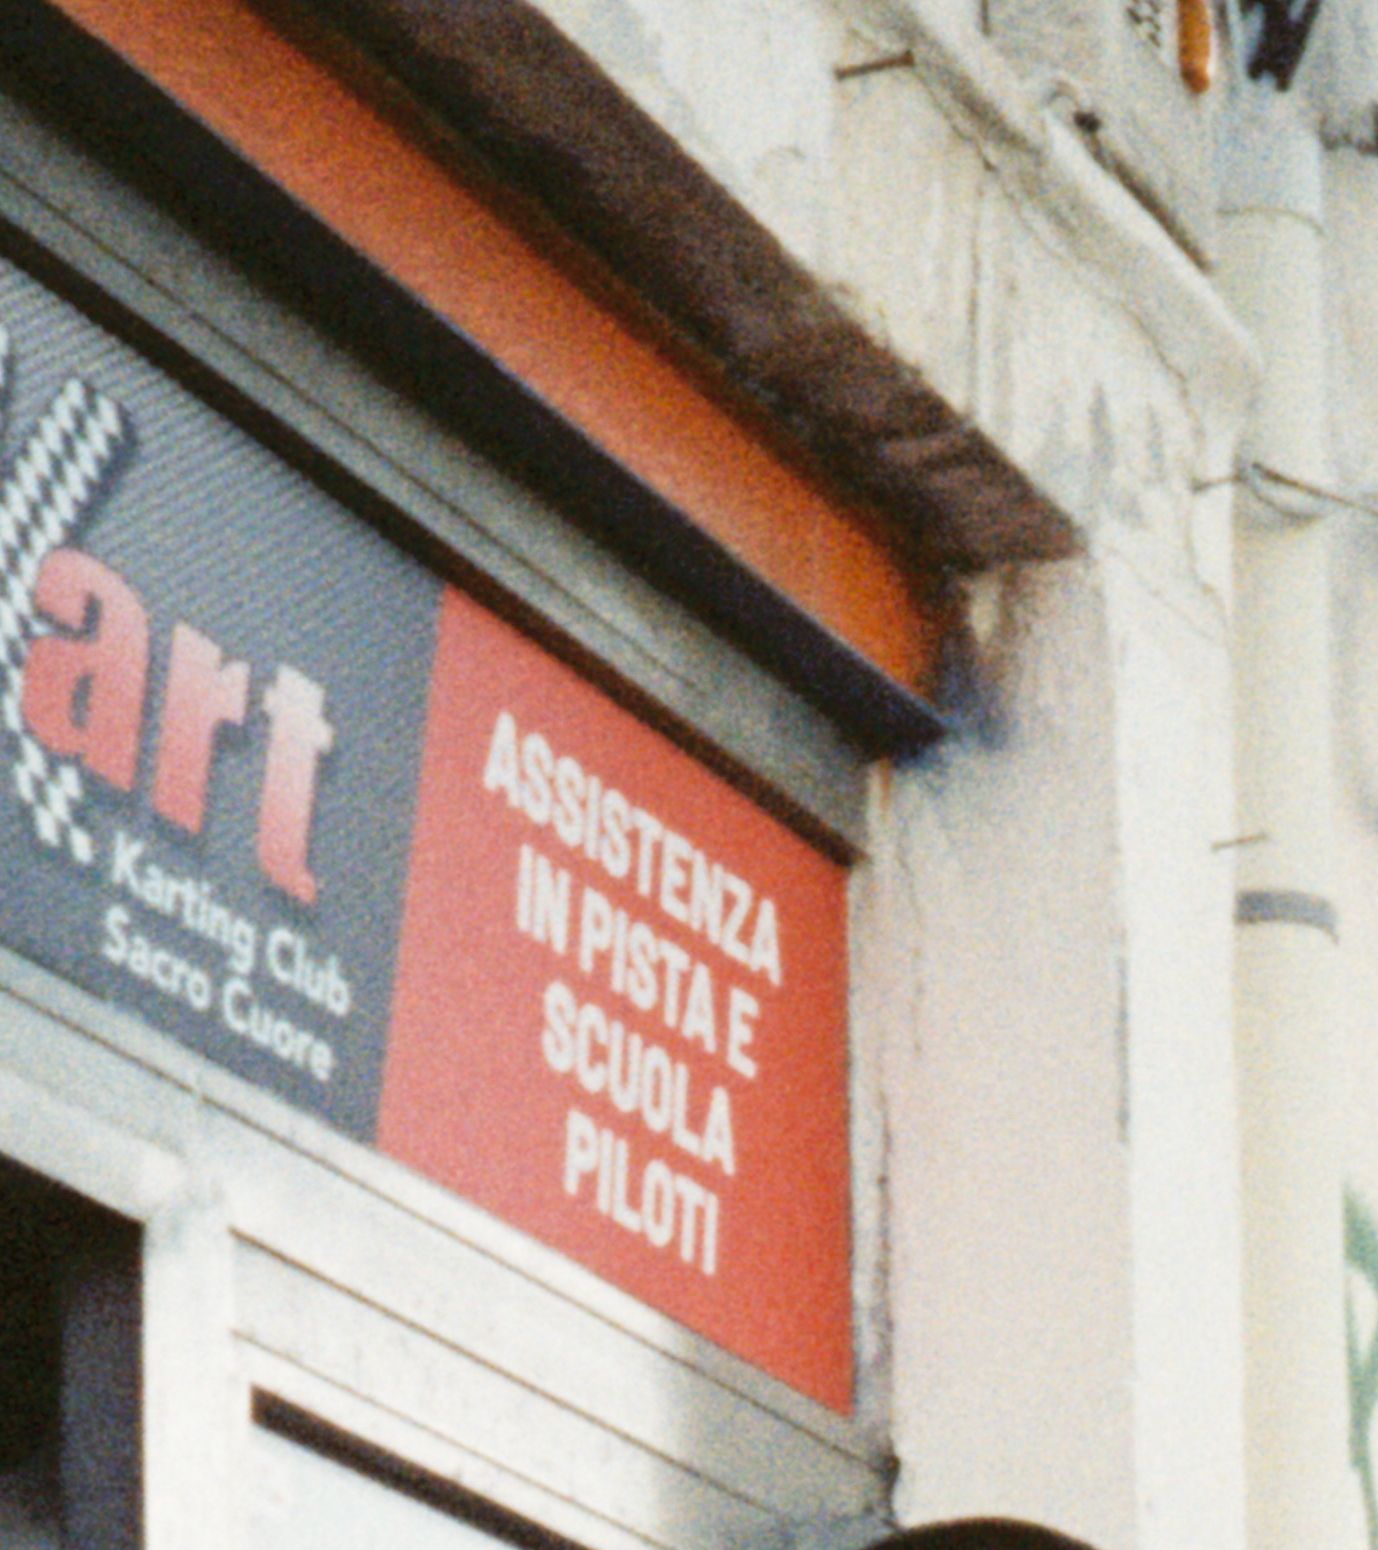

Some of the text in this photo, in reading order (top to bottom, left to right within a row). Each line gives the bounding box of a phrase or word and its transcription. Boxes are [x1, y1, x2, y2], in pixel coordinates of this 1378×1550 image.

[110, 831, 351, 1017] Karting Club
[484, 712, 782, 988] ASSISTENZA
[104, 905, 333, 1081] Sacro Cuore
[517, 843, 760, 1080] IN PISTA E
[542, 981, 736, 1176] SCUOLA
[563, 1109, 719, 1276] PILOTI
